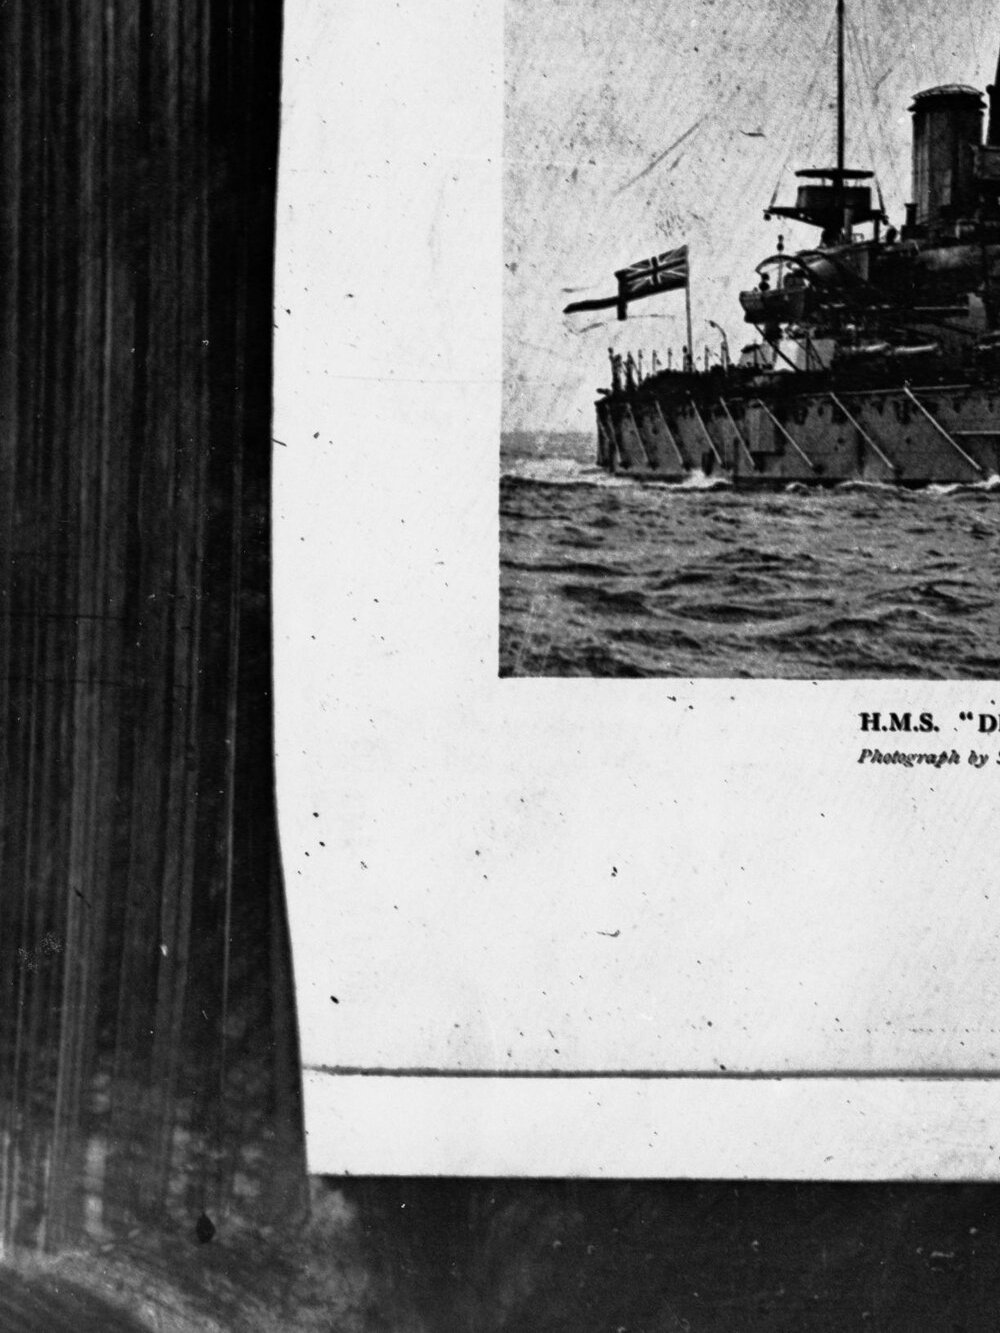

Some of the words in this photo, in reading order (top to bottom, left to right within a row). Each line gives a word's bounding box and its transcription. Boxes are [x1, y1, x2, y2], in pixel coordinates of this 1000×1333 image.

[858, 712, 940, 733] H.M.S.
[857, 748, 961, 769] Photograph
[967, 749, 990, 769] by
